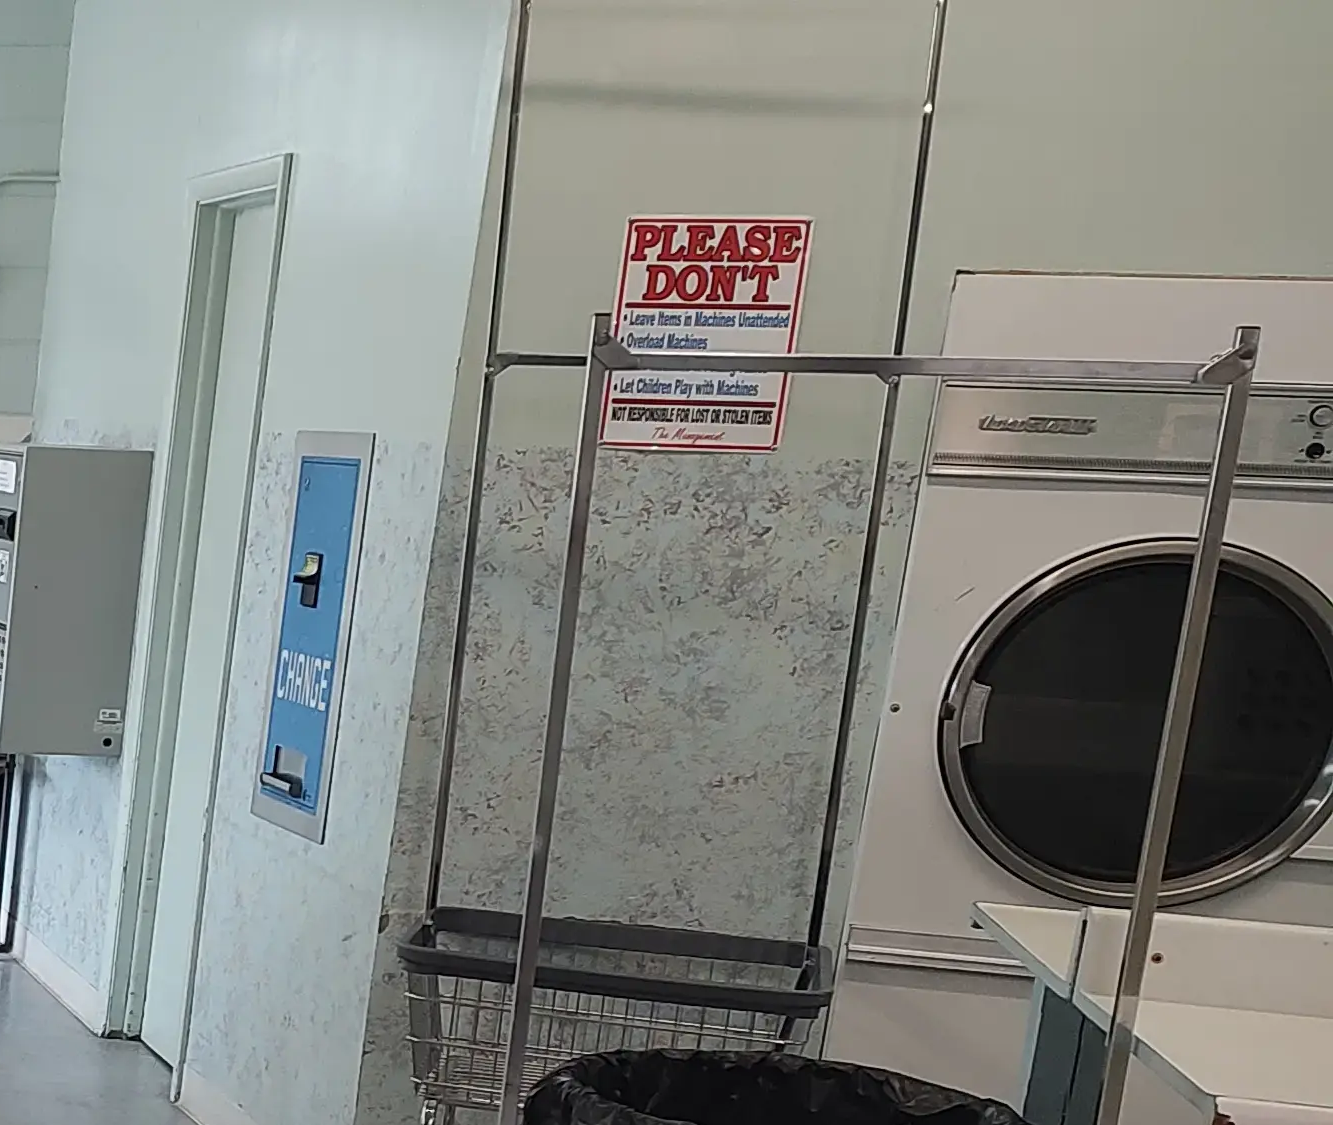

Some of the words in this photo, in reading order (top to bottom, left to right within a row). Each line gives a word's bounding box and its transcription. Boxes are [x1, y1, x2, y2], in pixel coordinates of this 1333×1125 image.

[630, 224, 802, 263] PLEASE
[642, 265, 779, 302] DON'T
[629, 310, 655, 326] Leave
[658, 311, 681, 327] Items
[684, 311, 692, 326] in
[694, 312, 736, 327] Machines
[738, 312, 790, 329] Unattended
[626, 332, 665, 349] Overload
[667, 333, 708, 350] Machines
[619, 377, 635, 393] Let
[636, 378, 672, 394] Children
[674, 379, 694, 398] Play
[695, 379, 715, 395] with
[716, 380, 759, 396] Machines
[611, 406, 627, 421] NOT
[627, 406, 675, 422] RESPONSIBLE
[676, 408, 690, 423] FOR
[691, 408, 710, 423] LOST
[711, 409, 721, 424] OR
[722, 409, 749, 425] STOLEN
[750, 410, 773, 426] ITEMS
[276, 648, 333, 713] CHANGE
